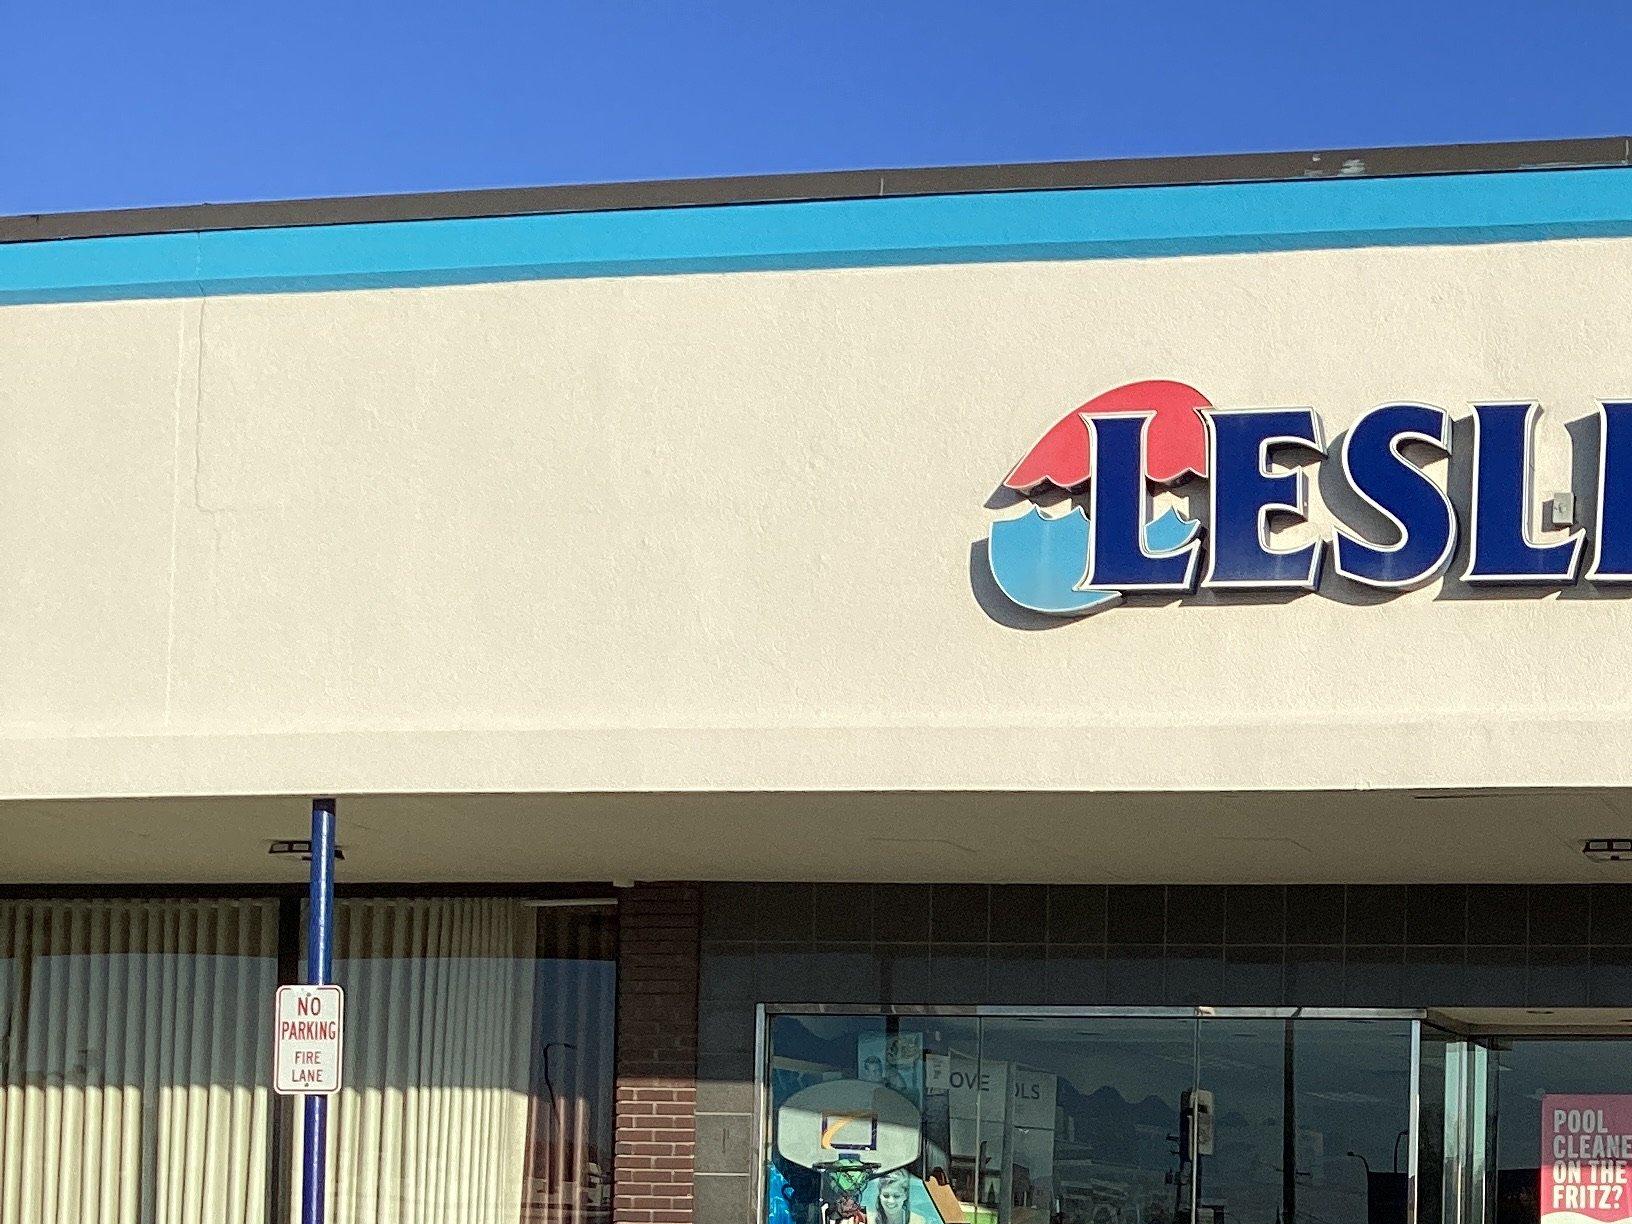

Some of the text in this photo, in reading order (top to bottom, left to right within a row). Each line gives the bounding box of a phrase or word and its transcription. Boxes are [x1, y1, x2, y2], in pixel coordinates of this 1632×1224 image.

[298, 997, 321, 1016] NO
[282, 1021, 336, 1040] PARKING
[295, 1051, 322, 1064] FIRE
[292, 1069, 323, 1083] LANE
[1553, 1109, 1608, 1133] POOL
[1553, 1160, 1628, 1184] ON THE
[1552, 1184, 1624, 1209] FRITZ?
